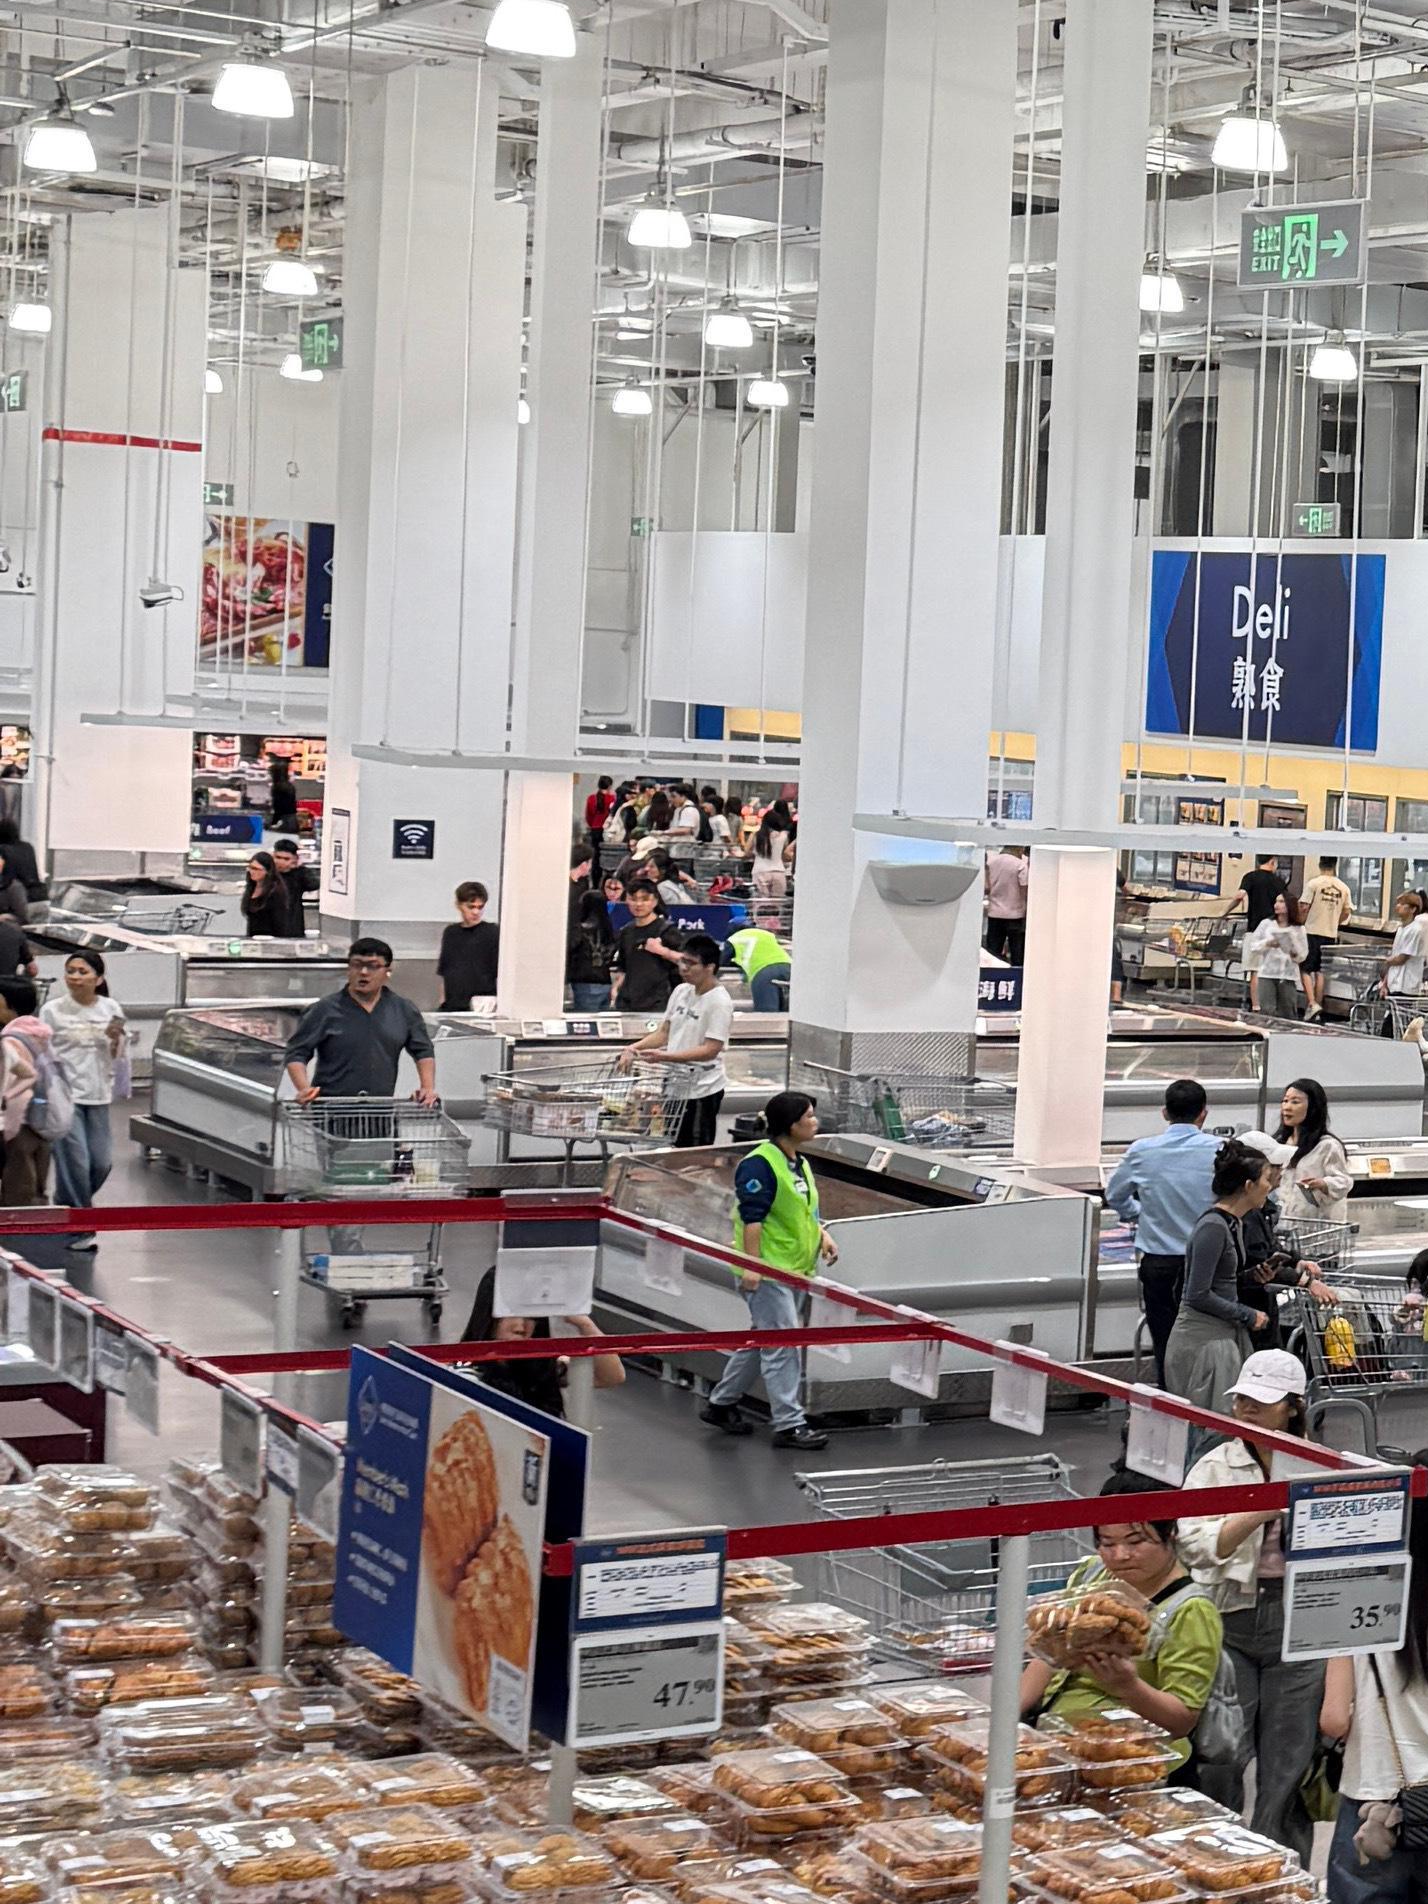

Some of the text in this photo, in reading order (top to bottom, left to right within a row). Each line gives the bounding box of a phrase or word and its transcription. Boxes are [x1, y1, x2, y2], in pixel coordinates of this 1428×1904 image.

[1251, 255, 1280, 272] EXIT
[1231, 583, 1291, 640] Deli
[1230, 655, 1285, 712] 熟食
[677, 917, 705, 931] Pork
